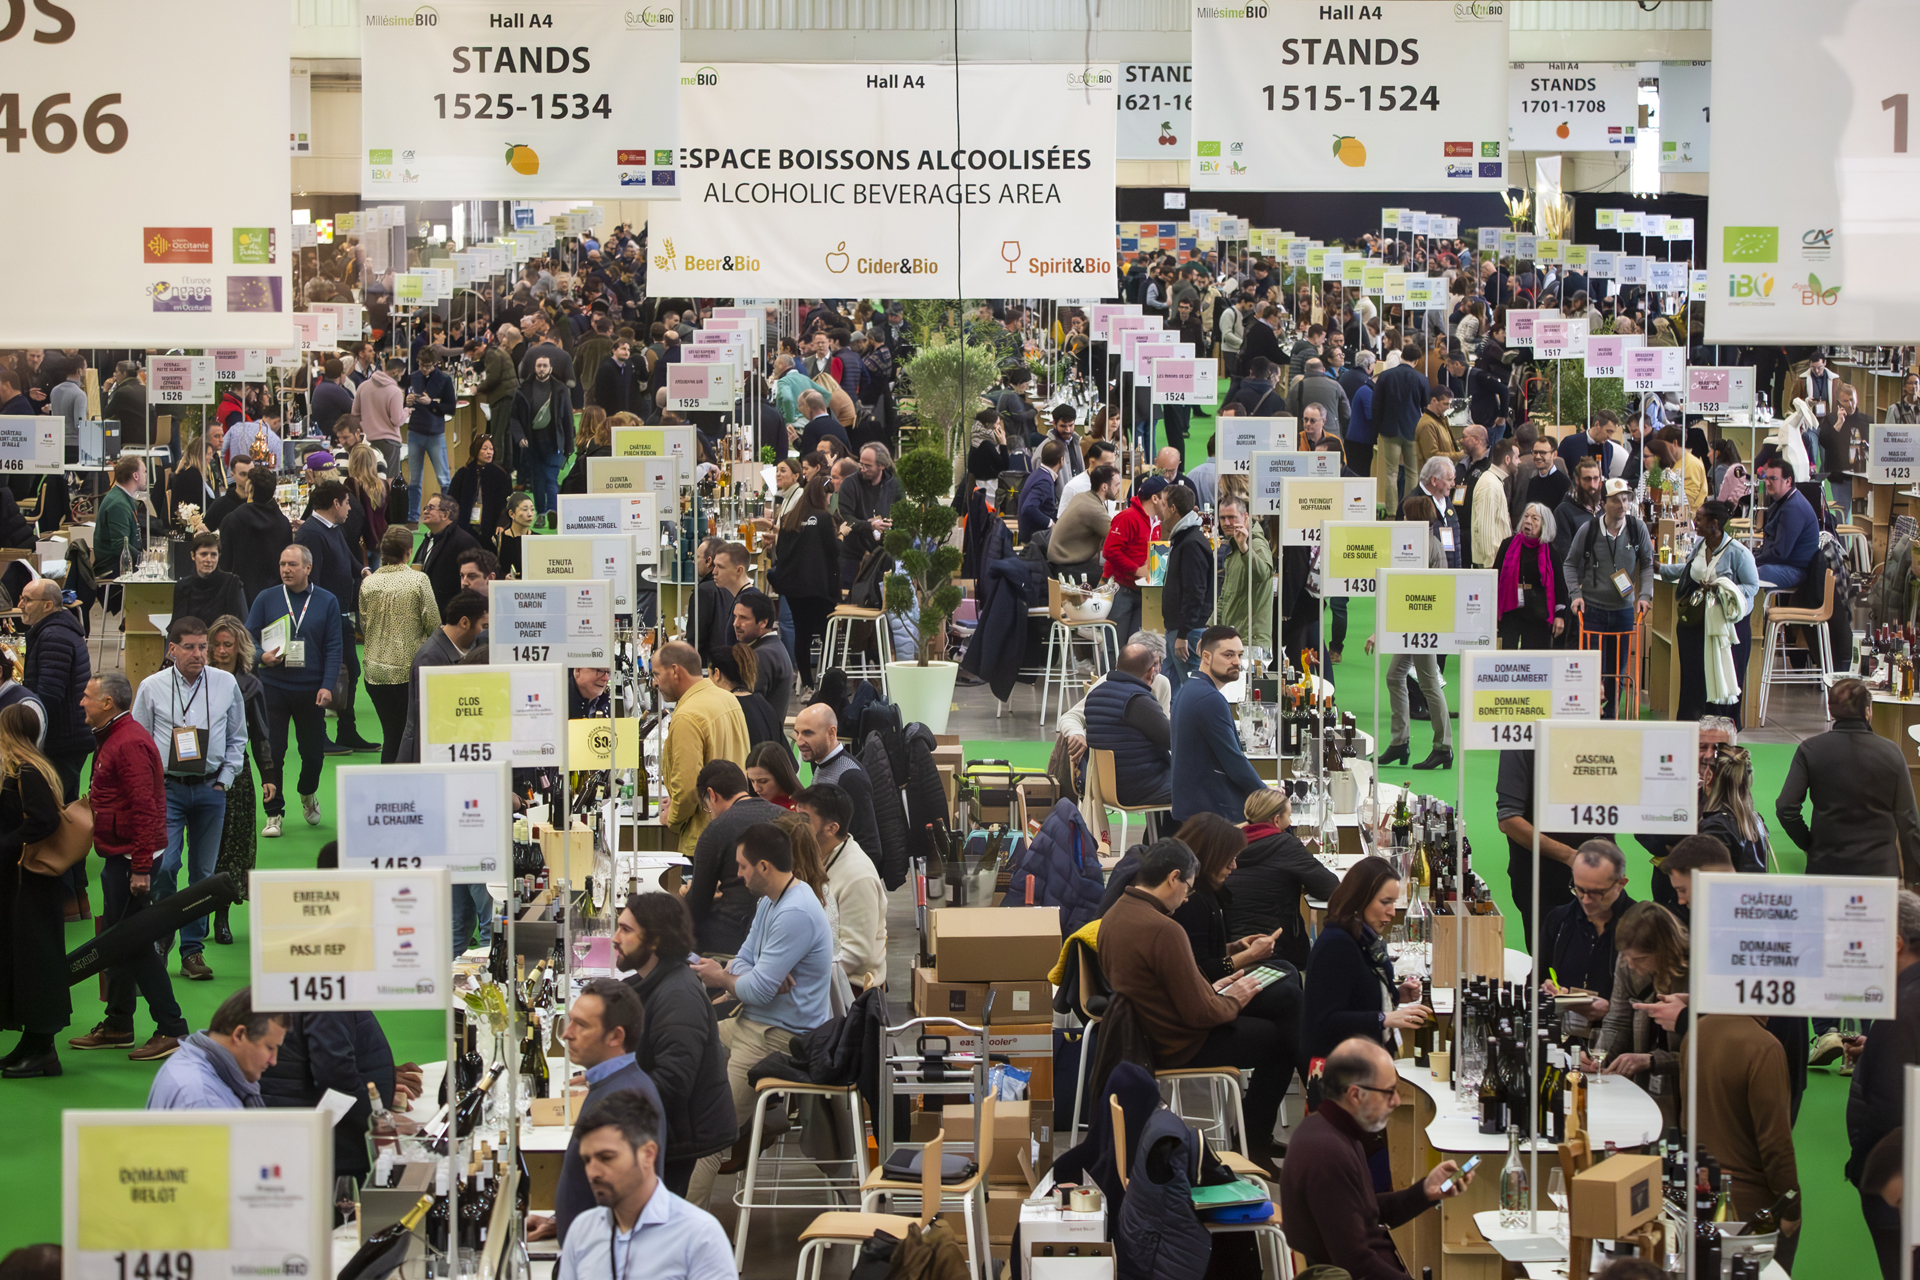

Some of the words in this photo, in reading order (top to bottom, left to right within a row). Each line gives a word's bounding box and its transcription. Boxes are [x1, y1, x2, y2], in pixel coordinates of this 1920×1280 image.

[1319, 5, 1354, 20] Hall
[1358, 6, 1383, 20] A4
[490, 14, 525, 28] Hall
[529, 14, 553, 28] A4
[1282, 38, 1420, 66] STANDS
[452, 46, 591, 74] STANDS
[1549, 62, 1566, 70] Hall
[1126, 66, 1192, 83] STAND
[866, 75, 899, 89] Hall
[903, 75, 926, 89] A4
[1530, 77, 1597, 92] STANDS
[1262, 85, 1440, 112] 1515-1524
[434, 93, 612, 120] 1525-1534
[1521, 100, 1606, 114] 1701-1708
[680, 148, 771, 170] ESPACE
[778, 148, 911, 171] BOISSONS
[917, 145, 1092, 171] ALCOOLISÉES
[703, 182, 845, 205] ALCOHOLIC
[853, 183, 992, 205] BEVERAGES
[998, 183, 1062, 205] AREA
[684, 255, 761, 273] Beer&Bio
[857, 258, 939, 275] Cider&Bio
[1029, 256, 1111, 277] Spirit&Bio
[1802, 290, 1837, 306] BIO
[1516, 337, 1533, 345] 1515
[1544, 349, 1561, 357] 1517
[217, 371, 236, 380] 1528
[1596, 367, 1614, 375] 1519
[1636, 380, 1653, 389] 1521
[162, 392, 183, 401] 1526
[1165, 392, 1185, 401] 1524
[679, 399, 700, 408] 1525
[1699, 402, 1720, 412] 1523
[0, 460, 24, 471] 1466
[1234, 460, 1250, 471] 142
[1885, 468, 1910, 479] 1423
[579, 515, 605, 523] DOMAINE
[567, 522, 618, 530] BAUMANN-ZIRGEL
[1301, 529, 1321, 542] 142
[1346, 544, 1375, 552] DOMAINE
[1356, 551, 1378, 559] SOULIÉ
[1344, 579, 1376, 593] 1430
[514, 592, 547, 600] DOMAINE
[519, 601, 543, 609] BARON
[1409, 603, 1433, 611] ROTIER
[514, 621, 547, 629] DOMAINE
[520, 630, 542, 638] PAGET
[1402, 633, 1438, 649] 1432
[513, 646, 550, 662] 1457
[1495, 664, 1531, 673] DOMAINE
[1477, 674, 1510, 683] ARNAUD
[1511, 674, 1548, 683] LAMBERT
[458, 697, 480, 706] CLOS
[1494, 697, 1530, 706] DOMAINE
[456, 708, 483, 717] D'ELLE
[1479, 707, 1514, 716] BONETTO
[1516, 707, 1546, 716] FABROL
[1491, 725, 1533, 743] 1434
[448, 743, 492, 762] 1455
[1575, 755, 1615, 764] CASCINA
[1573, 766, 1618, 776] ZERBETTA
[375, 800, 416, 813] PRIEURÉ
[368, 816, 380, 826] LA
[383, 815, 424, 826] CHAUME
[1571, 806, 1619, 825] 1436
[294, 891, 340, 903] EMERAN
[1741, 892, 1792, 906] CHÂTEAU
[303, 905, 332, 916] REYA
[1735, 906, 1798, 921] FRÉDIGNAC
[290, 944, 322, 956] PASJI
[324, 944, 346, 956] REP
[1740, 940, 1792, 953] DOMAINE
[1732, 954, 1747, 966] DE
[1750, 953, 1800, 967] L'ÉPINAY
[290, 976, 346, 1001] 1451
[1735, 979, 1796, 1005] 1438
[119, 1167, 188, 1184] DOMAINE
[131, 1187, 178, 1203] BELOT
[115, 1252, 193, 1280] 1449
